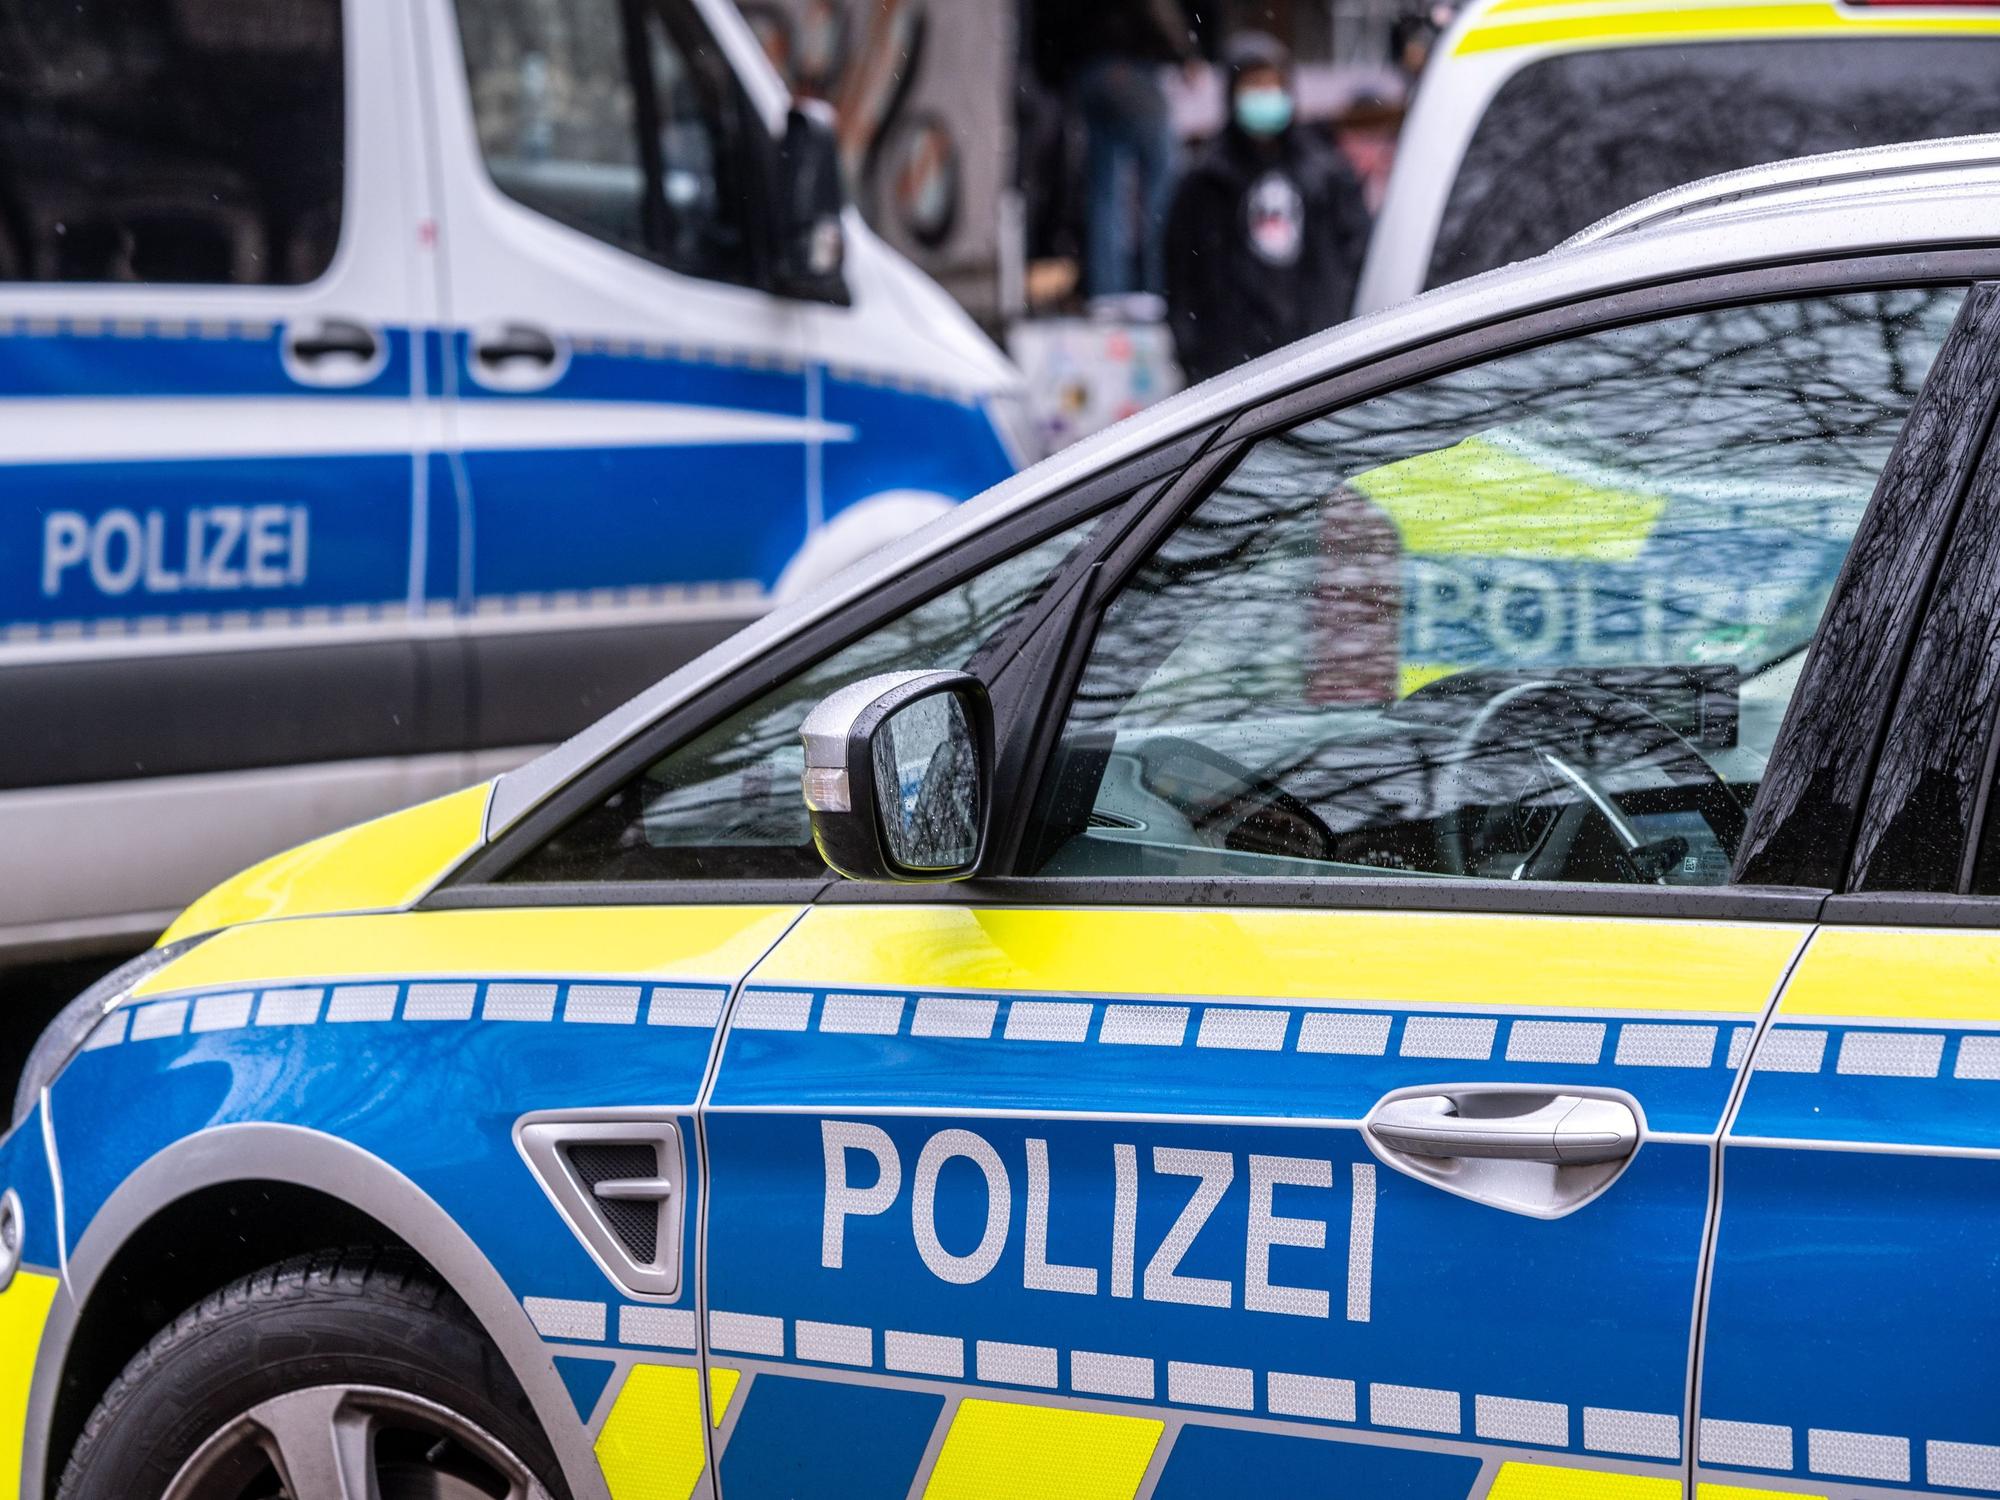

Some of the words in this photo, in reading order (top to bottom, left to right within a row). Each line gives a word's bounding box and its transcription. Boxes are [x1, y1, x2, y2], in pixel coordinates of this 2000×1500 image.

[42, 505, 308, 595] POLIZEI
[1413, 562, 1800, 664] POLI
[820, 1119, 1377, 1323] POLIZEI
